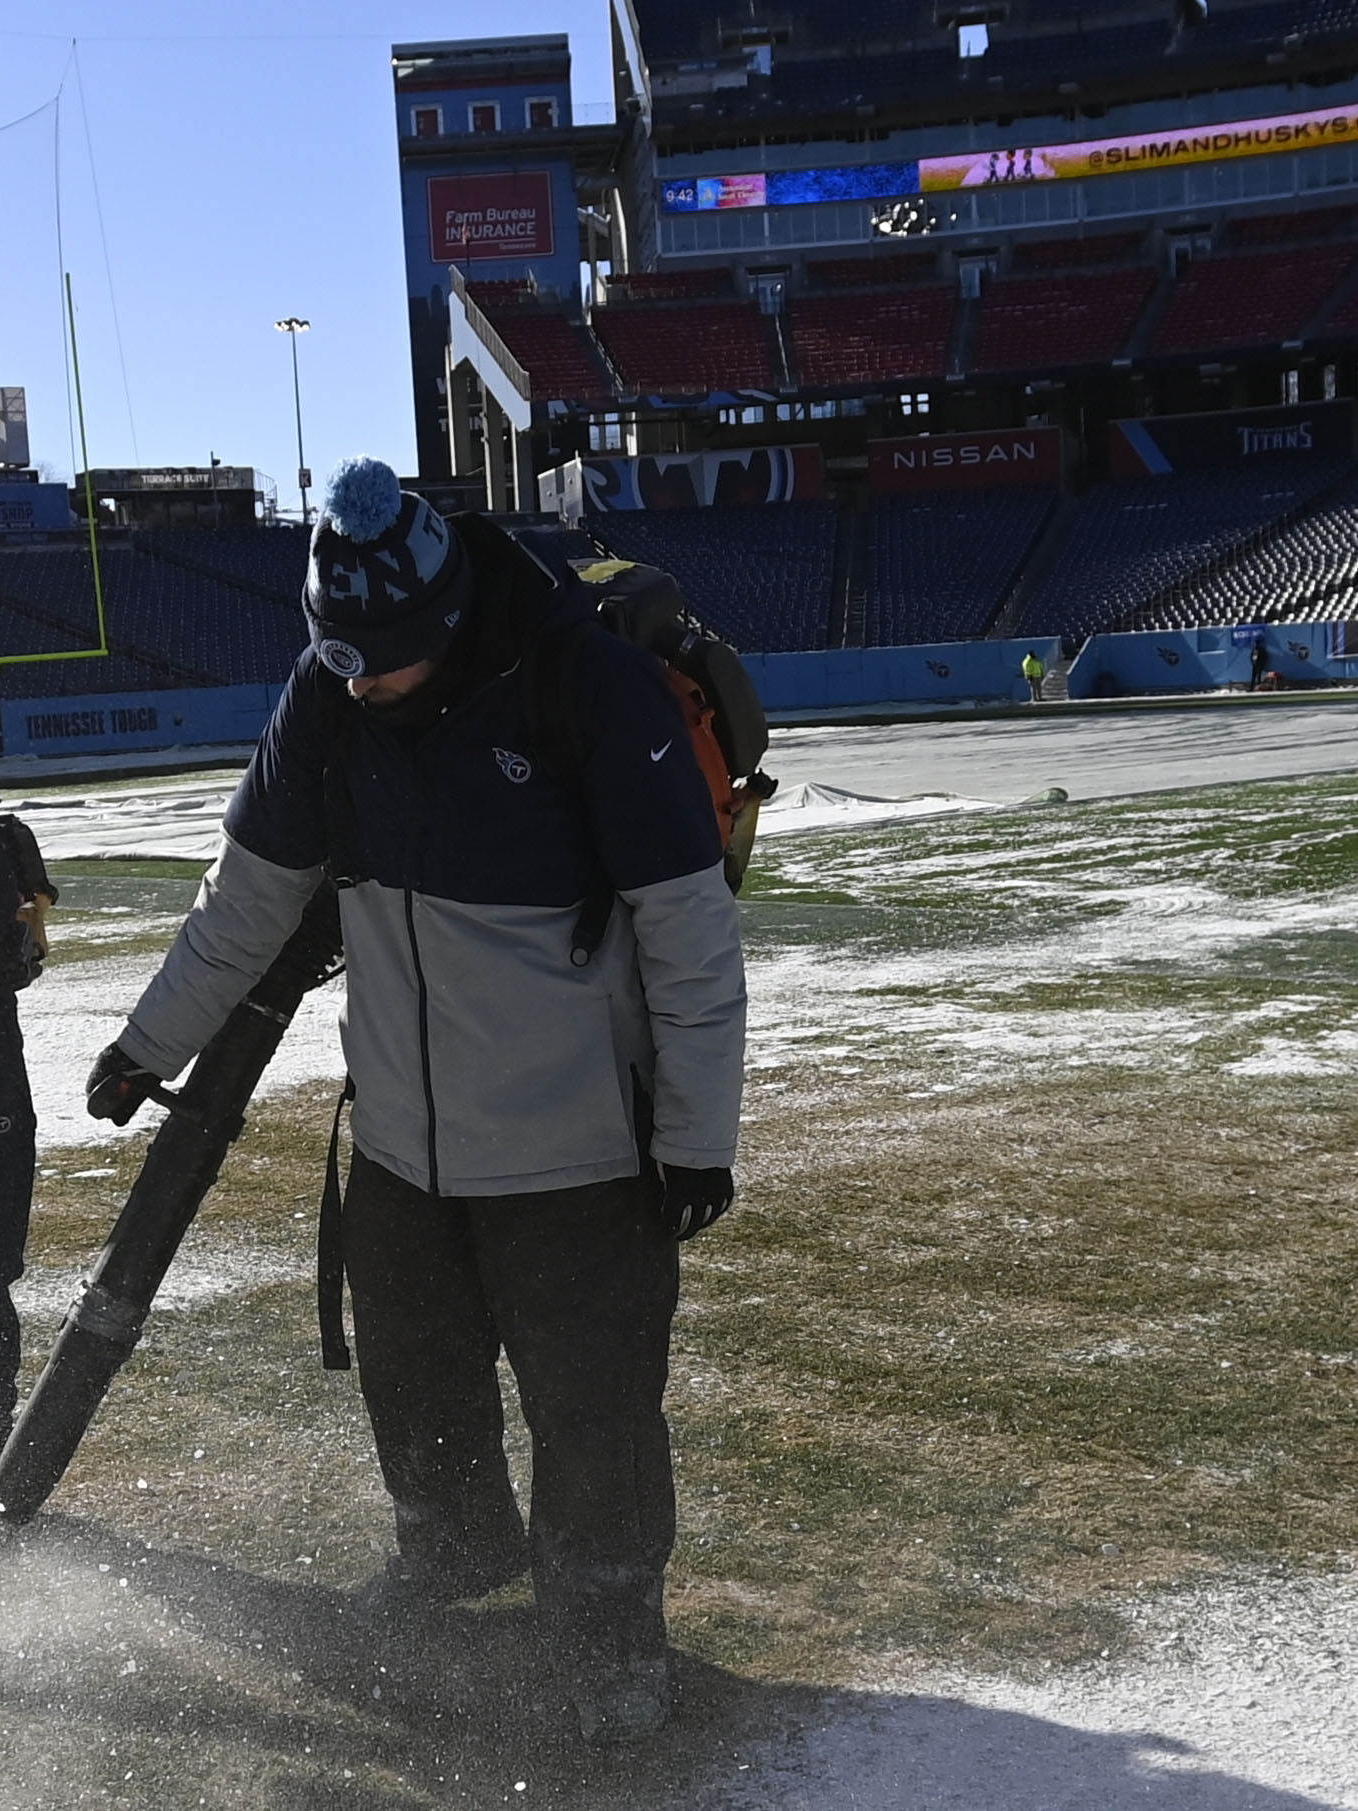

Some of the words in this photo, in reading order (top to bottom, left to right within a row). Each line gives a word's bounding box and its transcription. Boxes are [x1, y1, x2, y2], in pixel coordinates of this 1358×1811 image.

[1089, 115, 1358, 167] @SLIMANDHUSKYS.
[445, 210, 482, 224] Farm
[486, 208, 536, 221] Bureau
[1236, 420, 1314, 456] TITANS
[893, 441, 1036, 471] NISSAN
[25, 710, 105, 740] TENNESSEE
[110, 707, 159, 735] TOUGH
